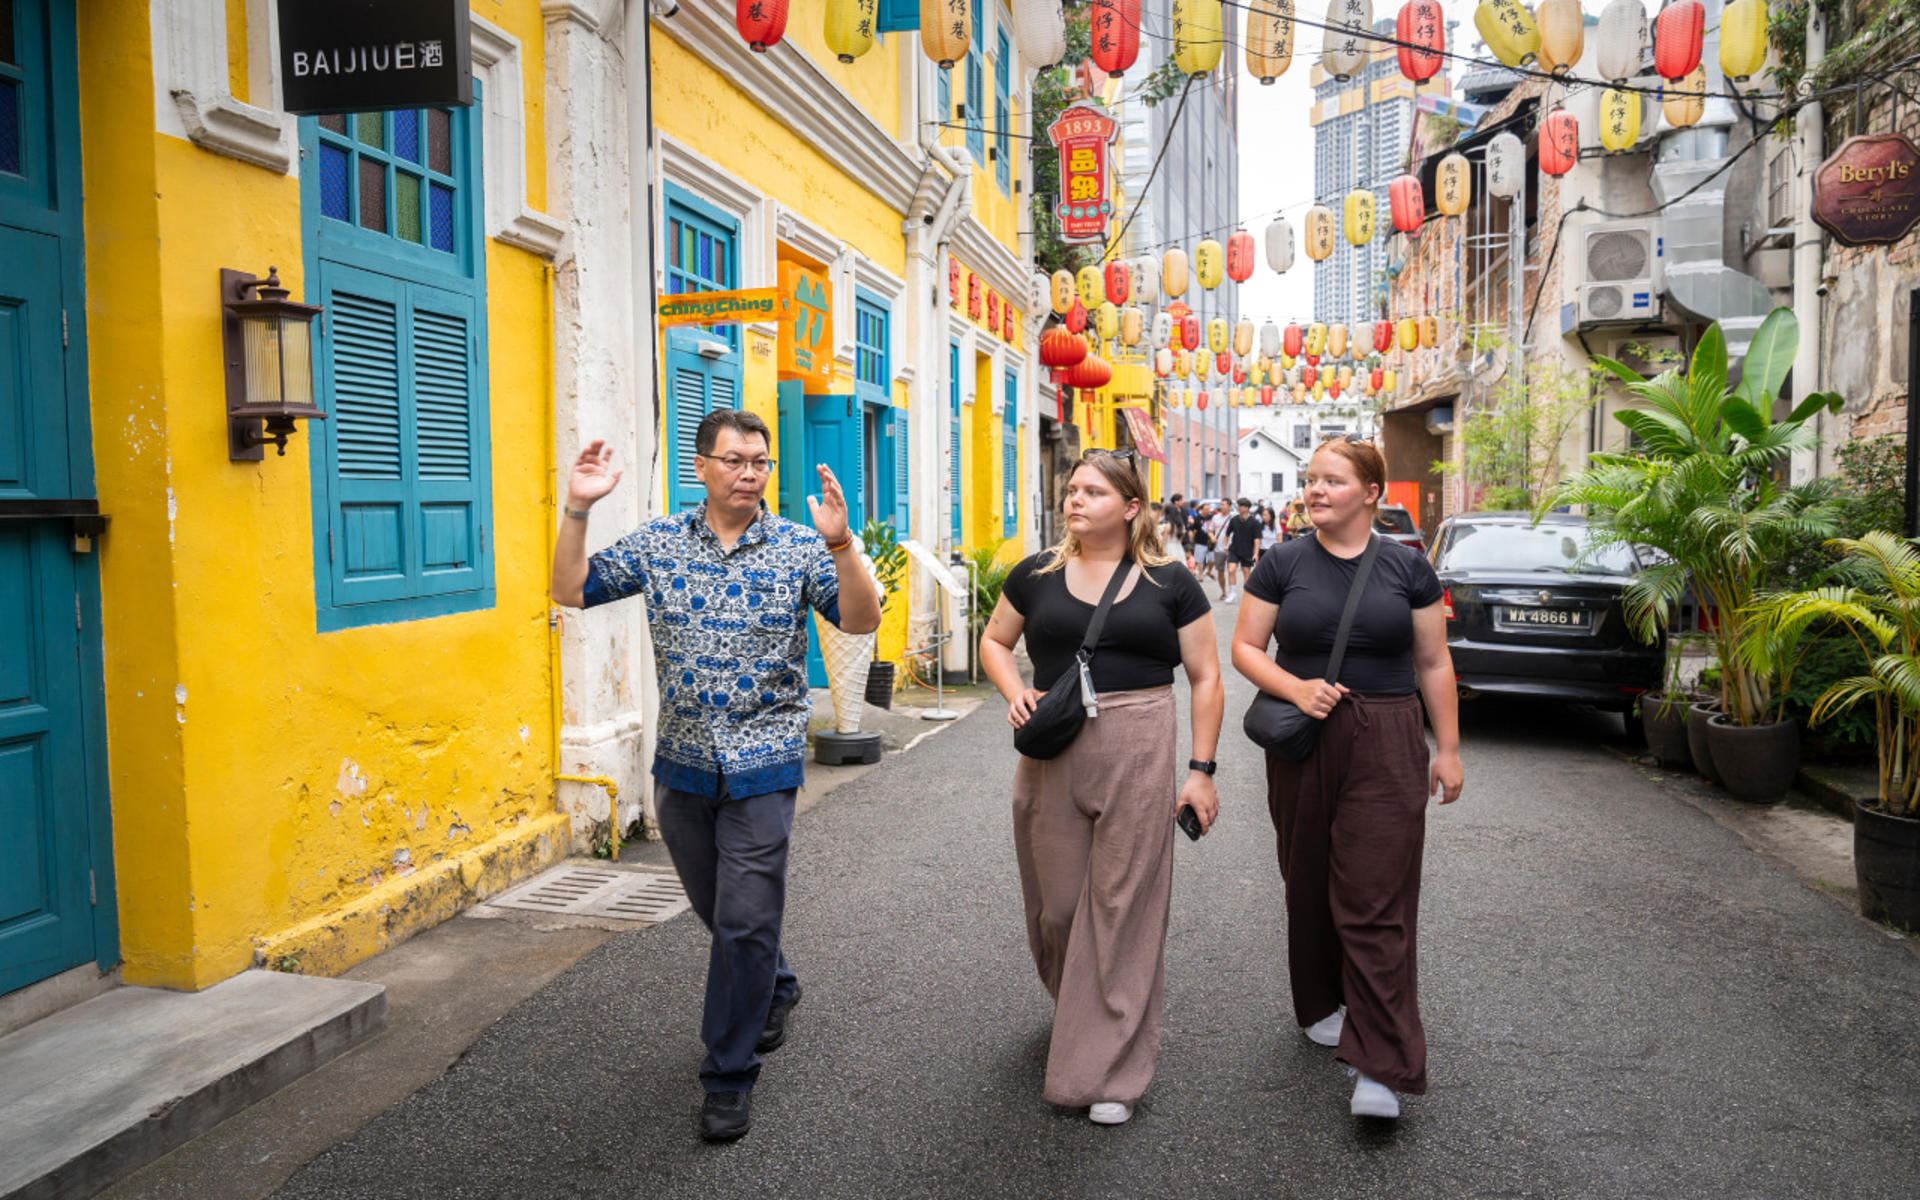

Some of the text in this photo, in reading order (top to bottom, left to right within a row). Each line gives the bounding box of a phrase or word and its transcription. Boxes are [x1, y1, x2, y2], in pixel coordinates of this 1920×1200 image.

[1065, 120, 1102, 134] 1893
[1840, 160, 1909, 187] Beryl's
[1509, 608, 1526, 622] WA
[1530, 610, 1568, 624] 4866
